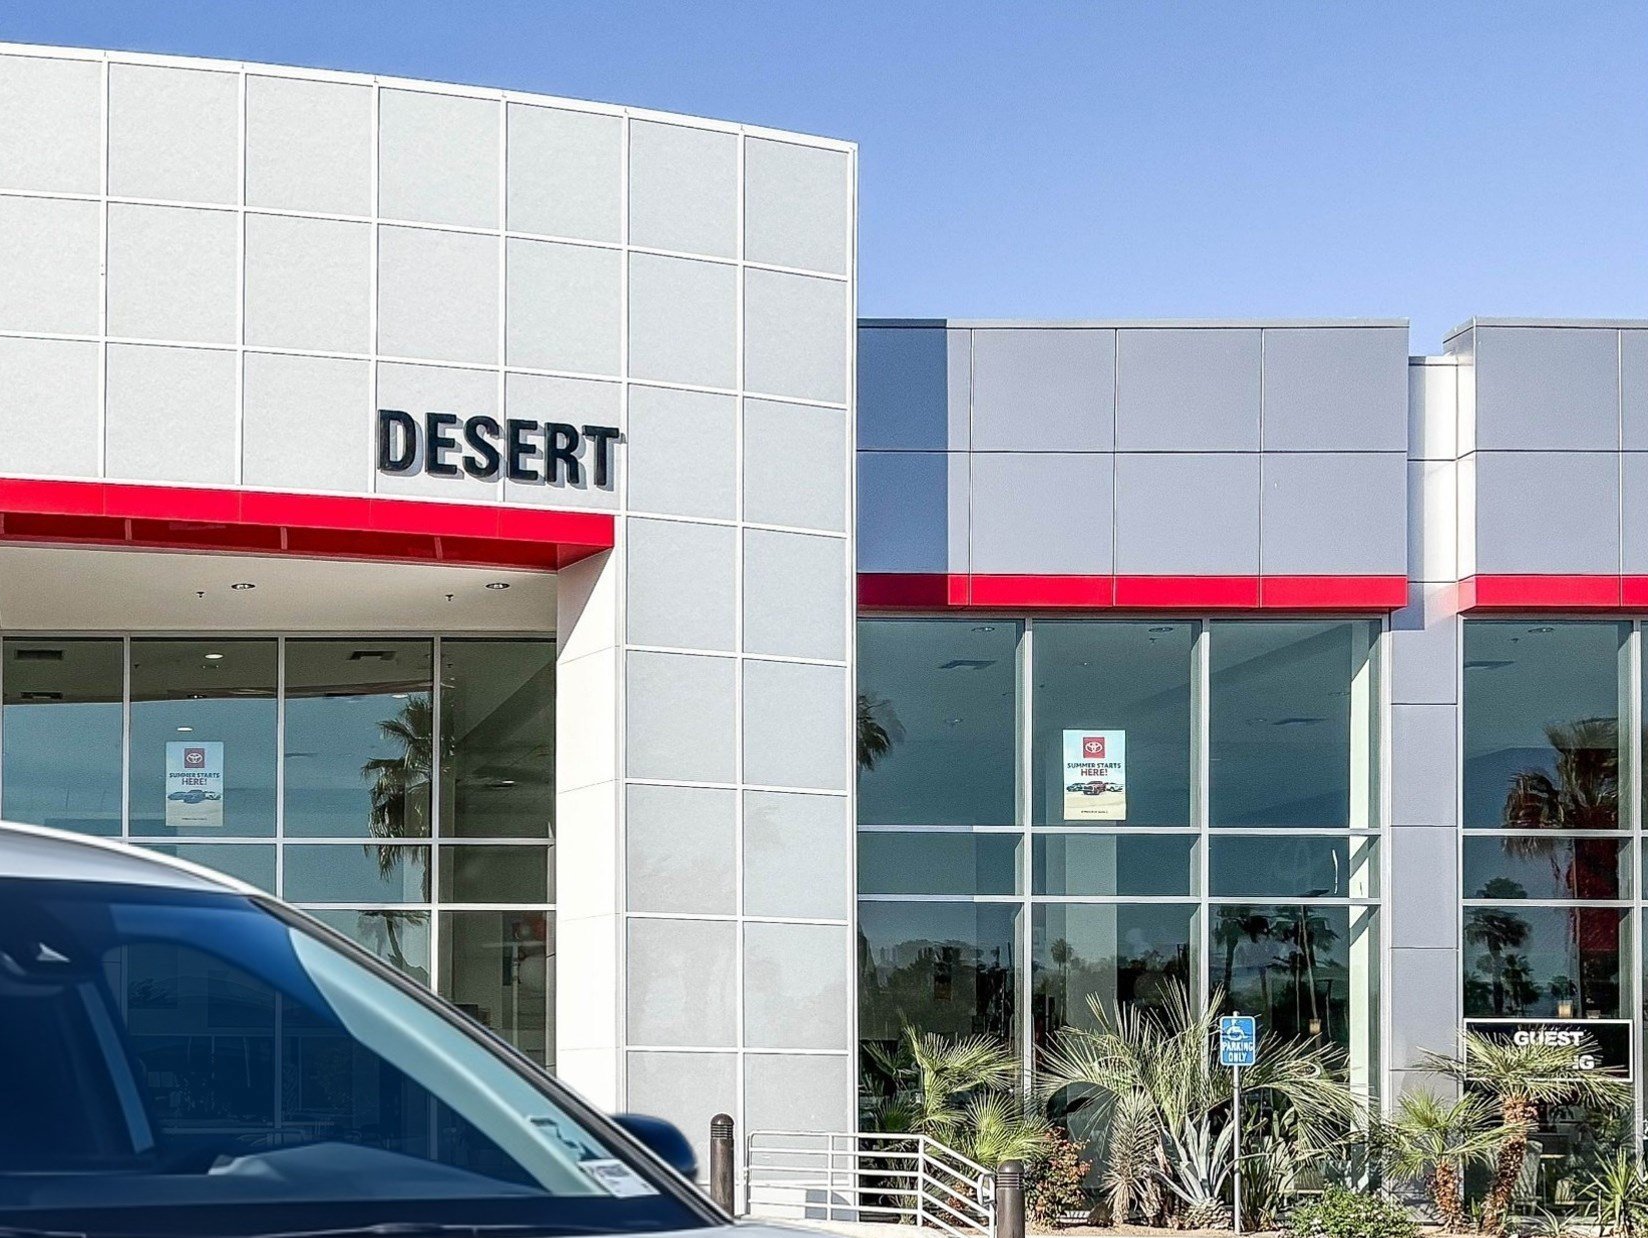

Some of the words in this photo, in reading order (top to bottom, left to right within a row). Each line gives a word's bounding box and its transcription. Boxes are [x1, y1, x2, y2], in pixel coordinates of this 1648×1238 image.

[377, 409, 620, 486] DESERT
[1080, 768, 1108, 776] HERE!
[1513, 1031, 1585, 1047] GUEST
[1222, 1041, 1254, 1051] PARKING
[1228, 1052, 1248, 1062] ONLY
